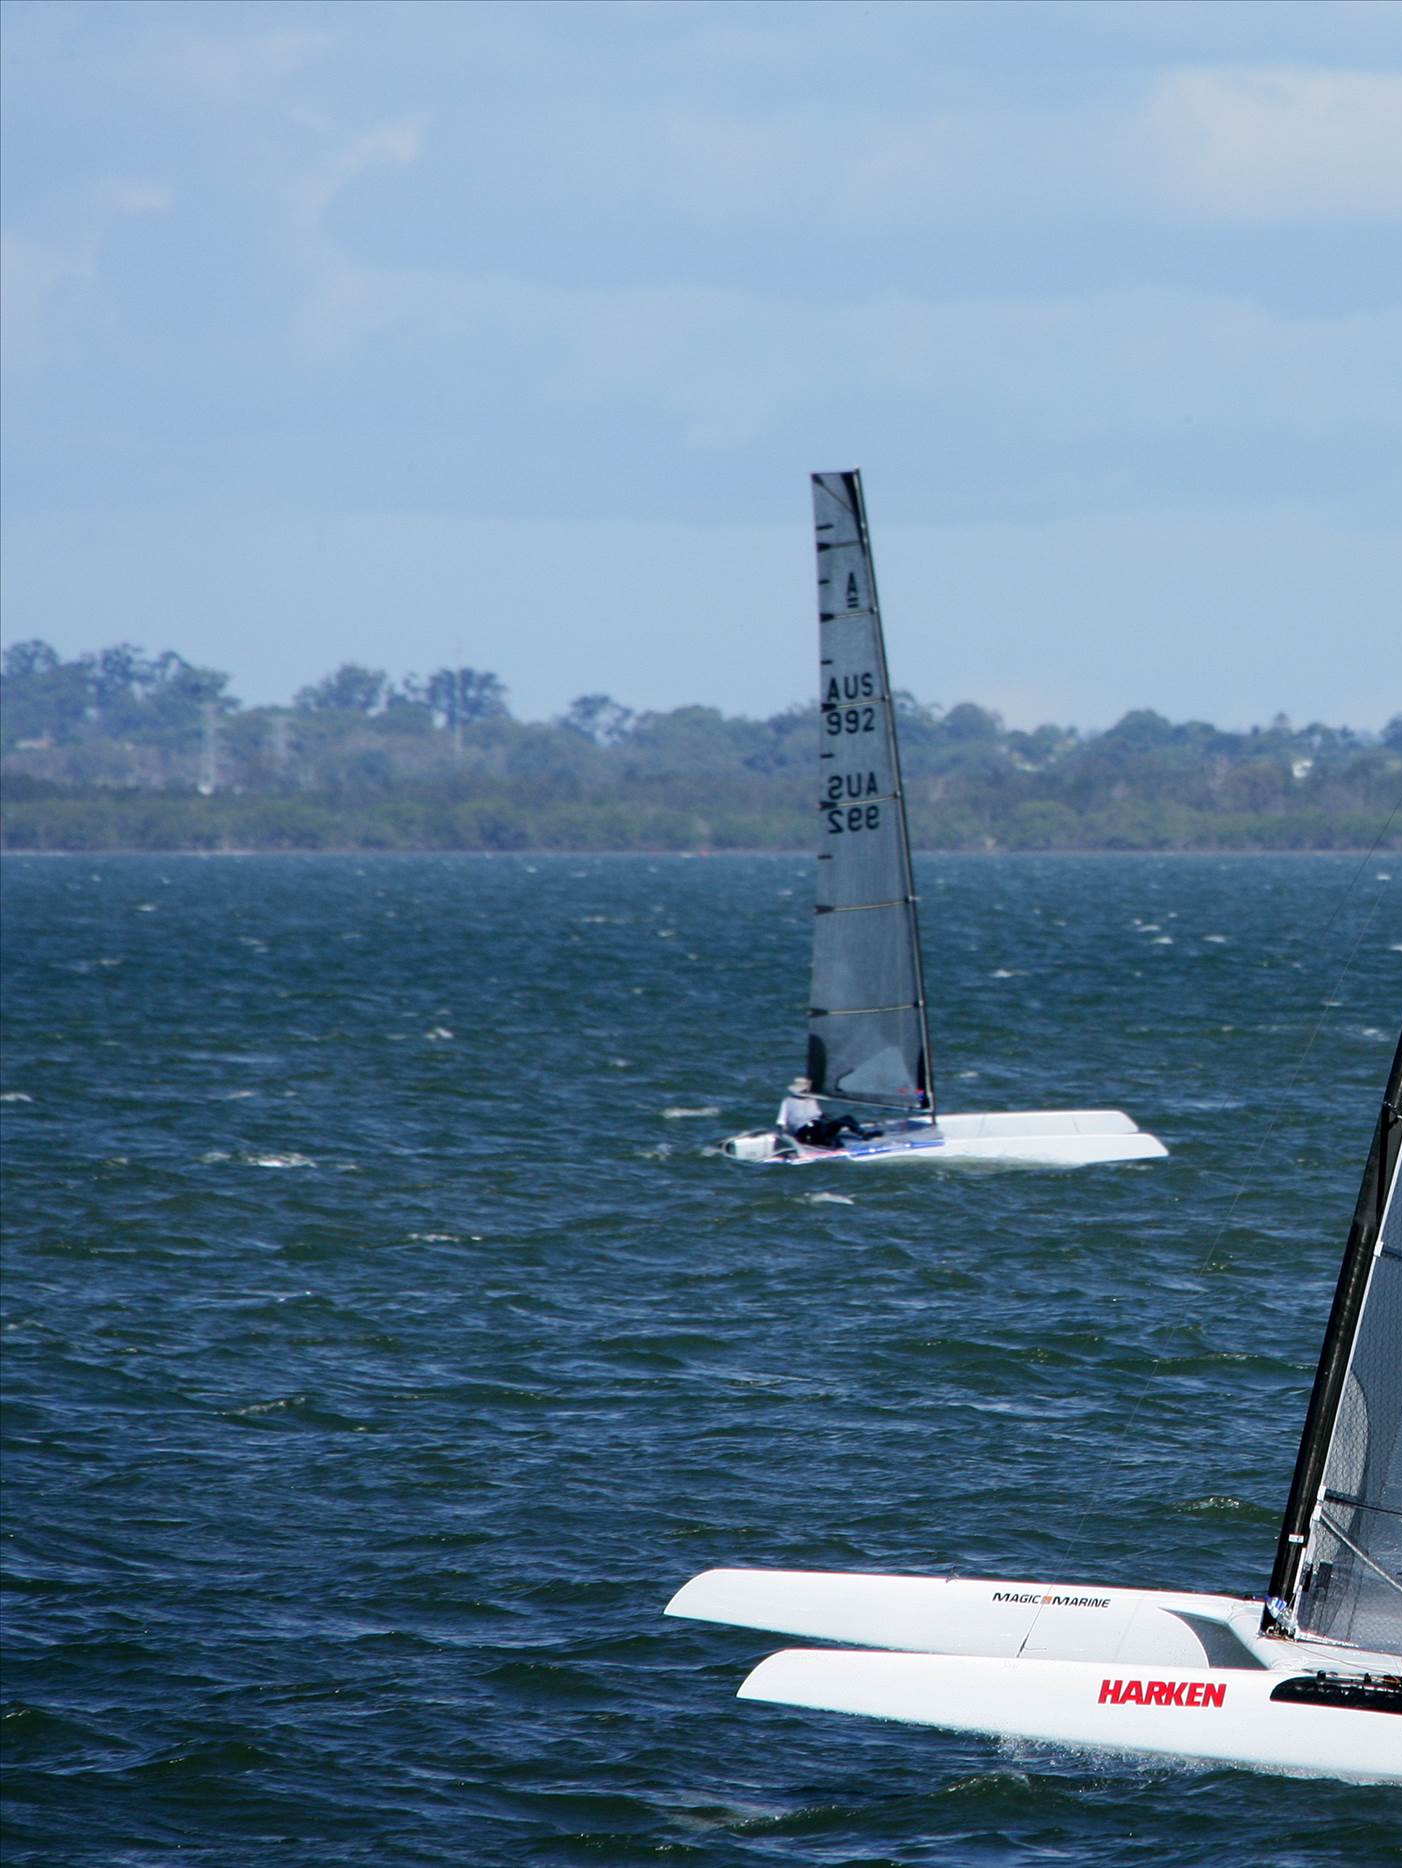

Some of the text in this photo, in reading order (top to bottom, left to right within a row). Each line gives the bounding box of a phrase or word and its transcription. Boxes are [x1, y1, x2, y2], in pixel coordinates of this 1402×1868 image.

[827, 672, 874, 701] AUS
[827, 707, 876, 736] 992
[992, 1592, 1112, 1608] MAGIC MARINE
[1097, 1679, 1227, 1708] HARKEN
